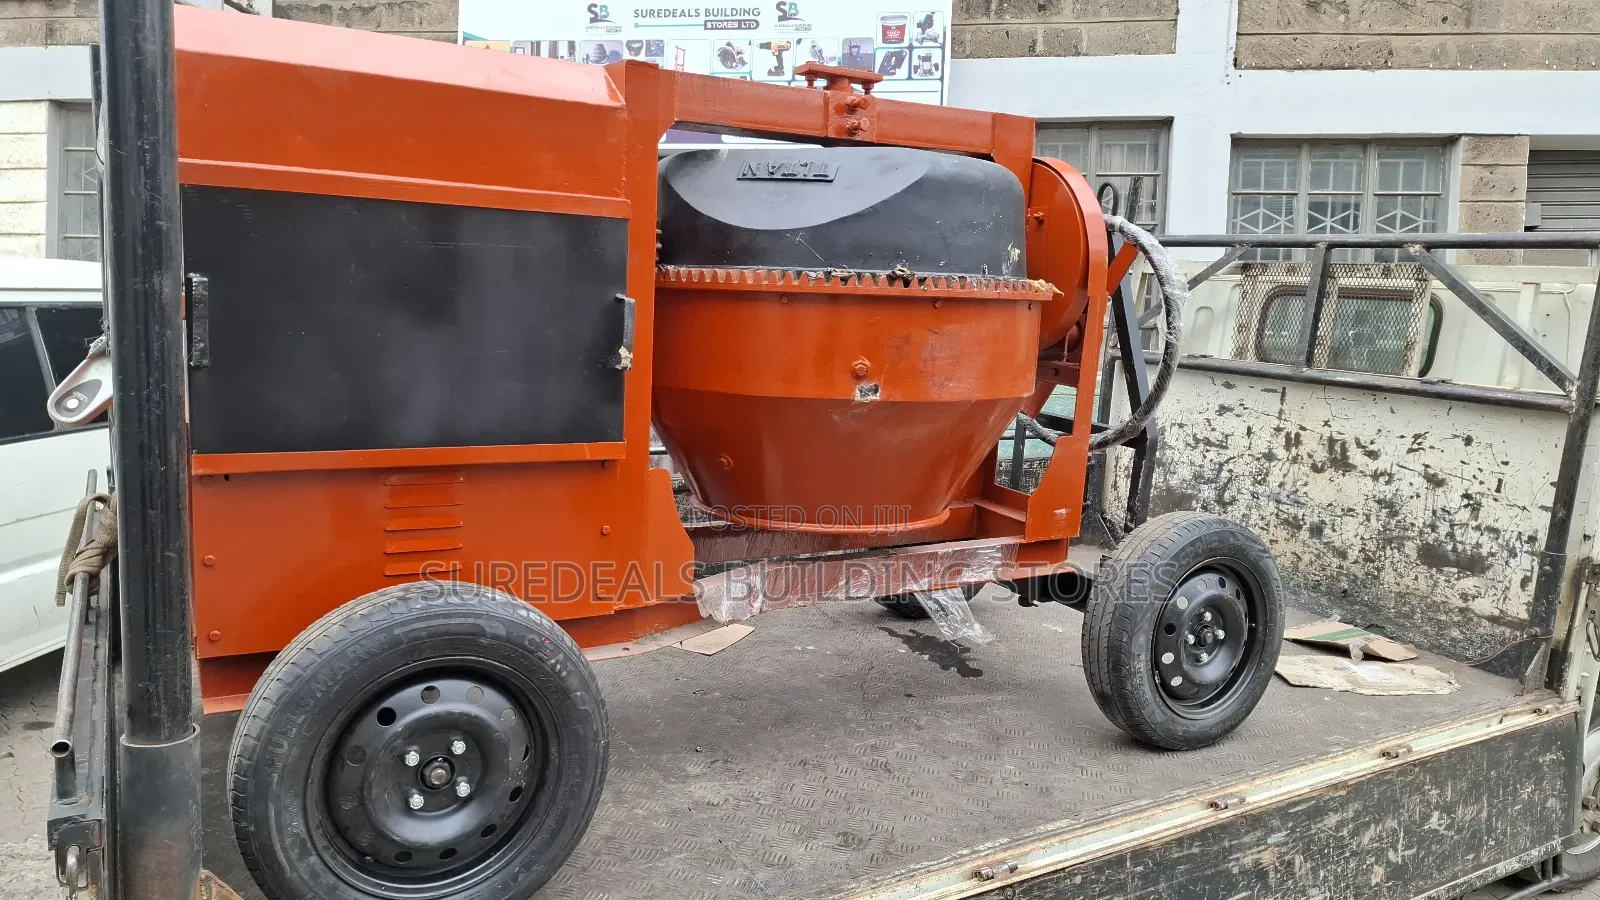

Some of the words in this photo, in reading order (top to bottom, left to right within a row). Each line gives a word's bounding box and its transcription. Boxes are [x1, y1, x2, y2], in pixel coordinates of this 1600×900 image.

[633, 8, 701, 19] SUREDEALS
[704, 7, 761, 18] BUILDING
[741, 161, 831, 178] TITAN
